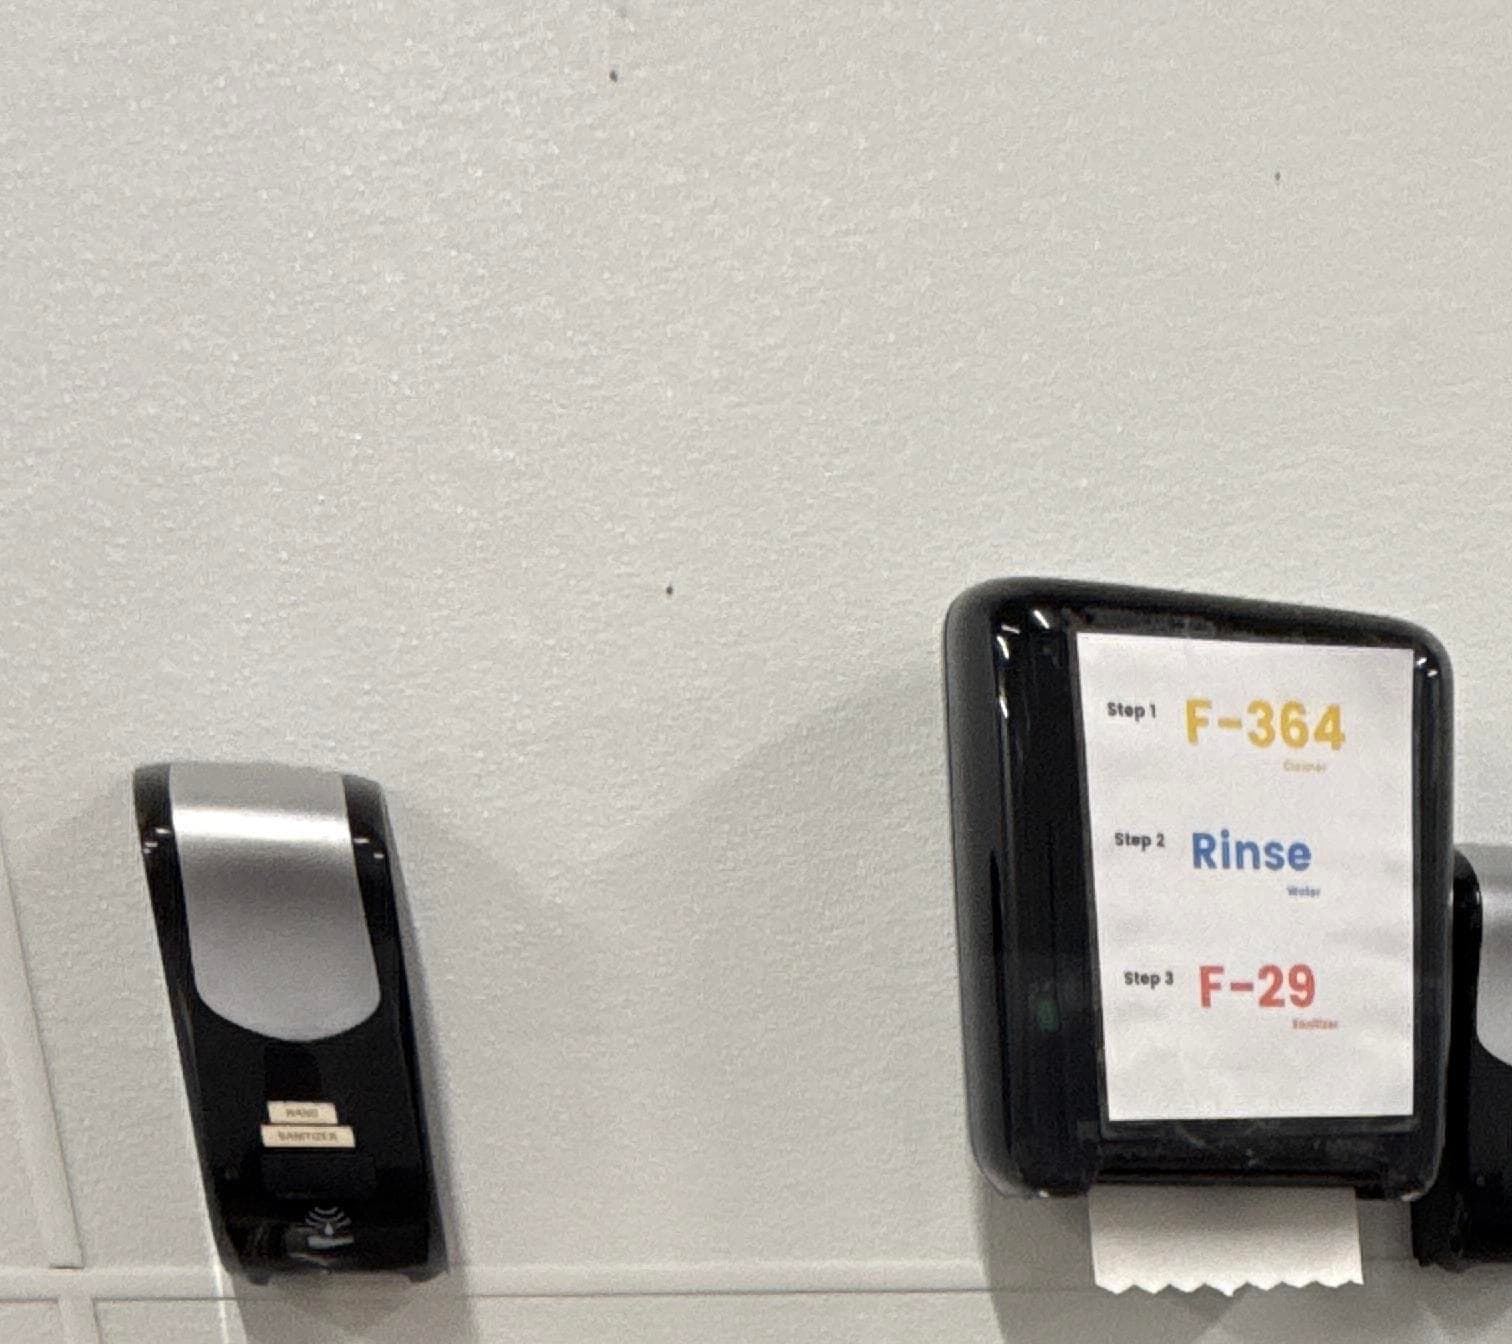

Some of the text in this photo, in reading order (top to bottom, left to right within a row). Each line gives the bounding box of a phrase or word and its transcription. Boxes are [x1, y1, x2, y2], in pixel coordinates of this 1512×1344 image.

[1107, 701, 1157, 721] Step 1
[1184, 697, 1346, 751] F-364
[1114, 832, 1166, 851] Step 2
[1192, 828, 1313, 871] Rinse
[1124, 971, 1175, 990] Step 3
[1199, 963, 1316, 1008] F-29
